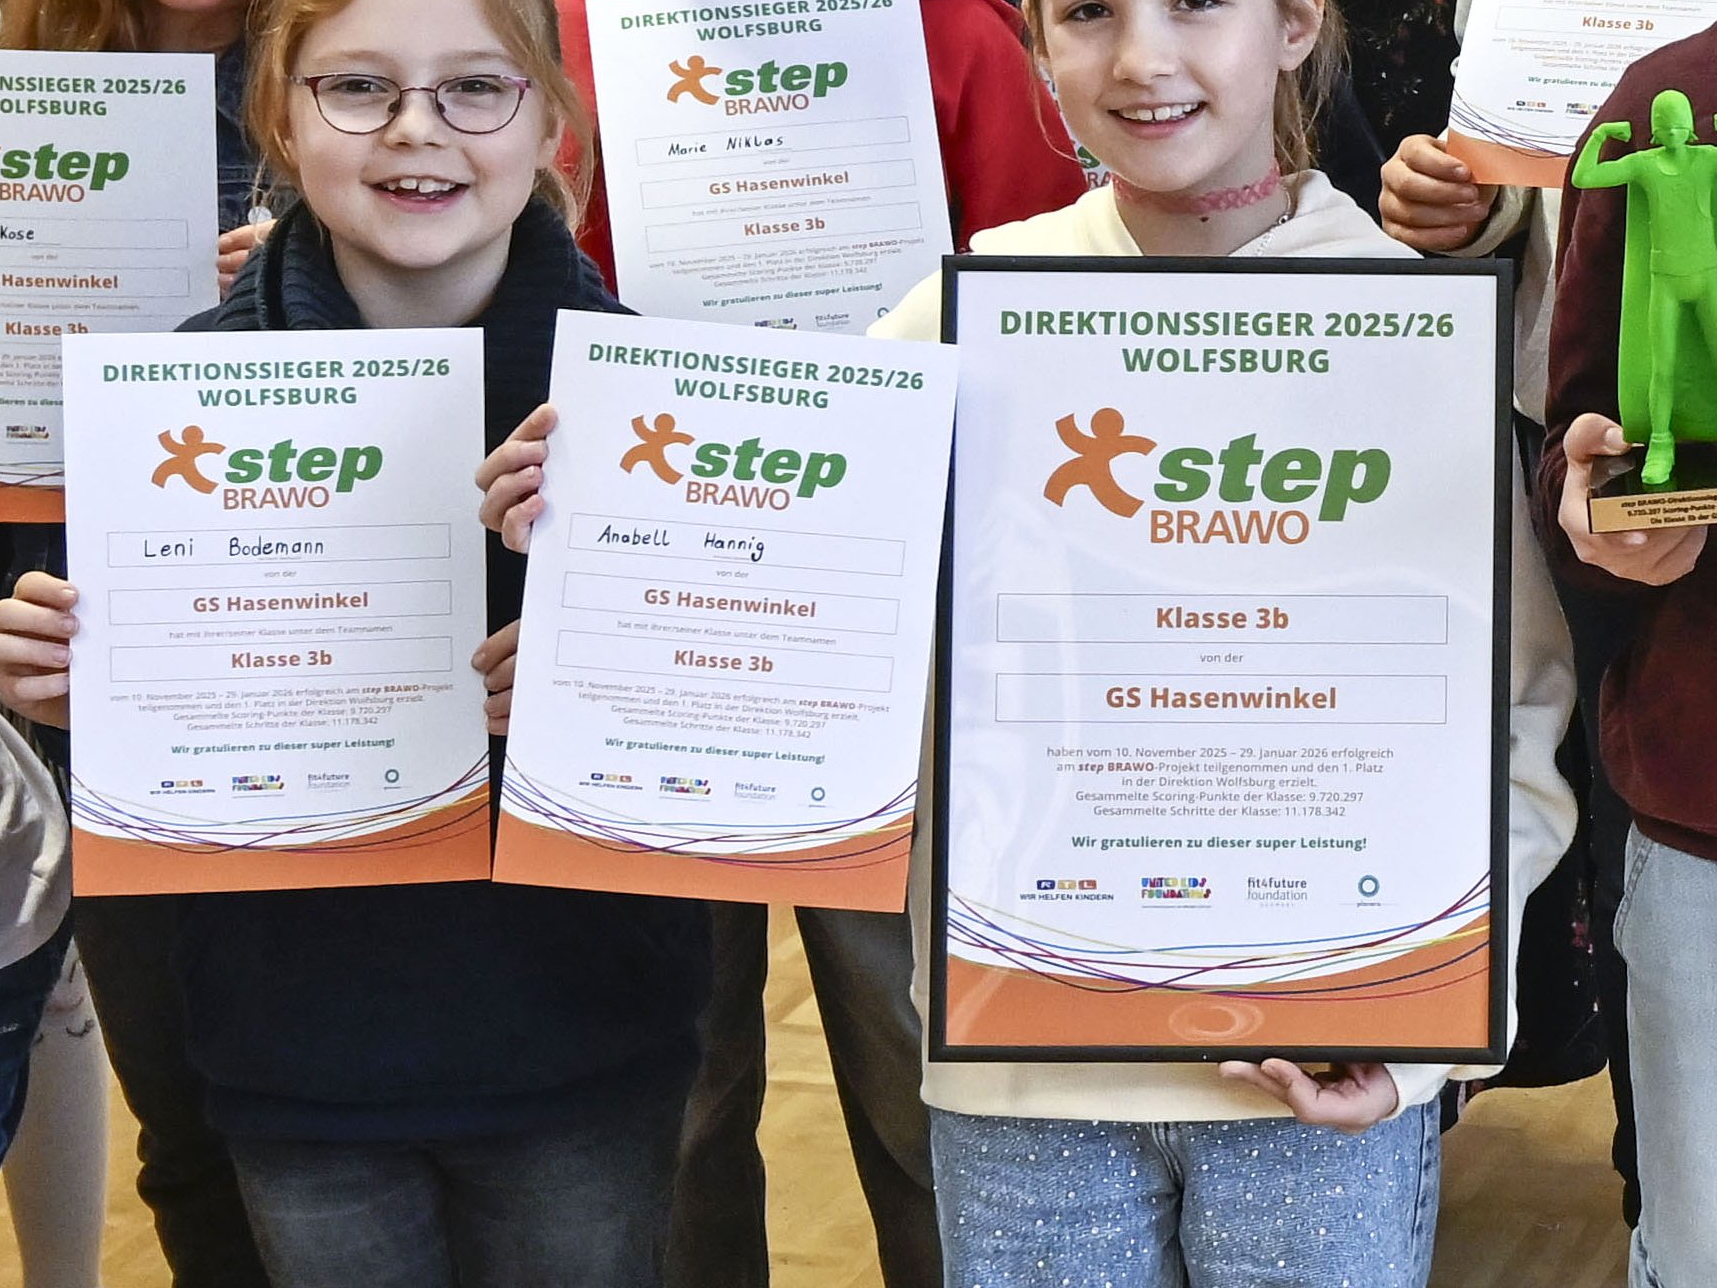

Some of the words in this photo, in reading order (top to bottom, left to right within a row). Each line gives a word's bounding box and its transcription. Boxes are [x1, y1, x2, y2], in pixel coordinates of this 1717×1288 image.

[668, 142, 707, 156] Marie
[1000, 311, 1314, 338] DIREKTIONSSIEGER
[1325, 311, 1454, 338] 2025/26
[1122, 349, 1330, 374] WOLFSBURG
[1155, 433, 1391, 522] step
[1151, 510, 1310, 545] BRAWO
[144, 538, 194, 558] Leni
[229, 537, 324, 556] Bodemann
[597, 523, 671, 548] Anabell
[704, 532, 765, 561] Hannig
[1156, 607, 1247, 630] Klasse
[1256, 607, 1290, 630] 3b
[1200, 654, 1218, 663] von
[1225, 653, 1244, 663] der
[1106, 687, 1142, 710] GS
[1150, 686, 1336, 710] Hasenwinkel
[1072, 837, 1096, 848] Wir
[1101, 836, 1182, 850] gratulieren
[1187, 839, 1202, 848] zu
[1207, 836, 1250, 848] dieser
[1256, 838, 1295, 851] super
[1300, 836, 1366, 850] Leistung!
[1247, 890, 1307, 901] foundation
